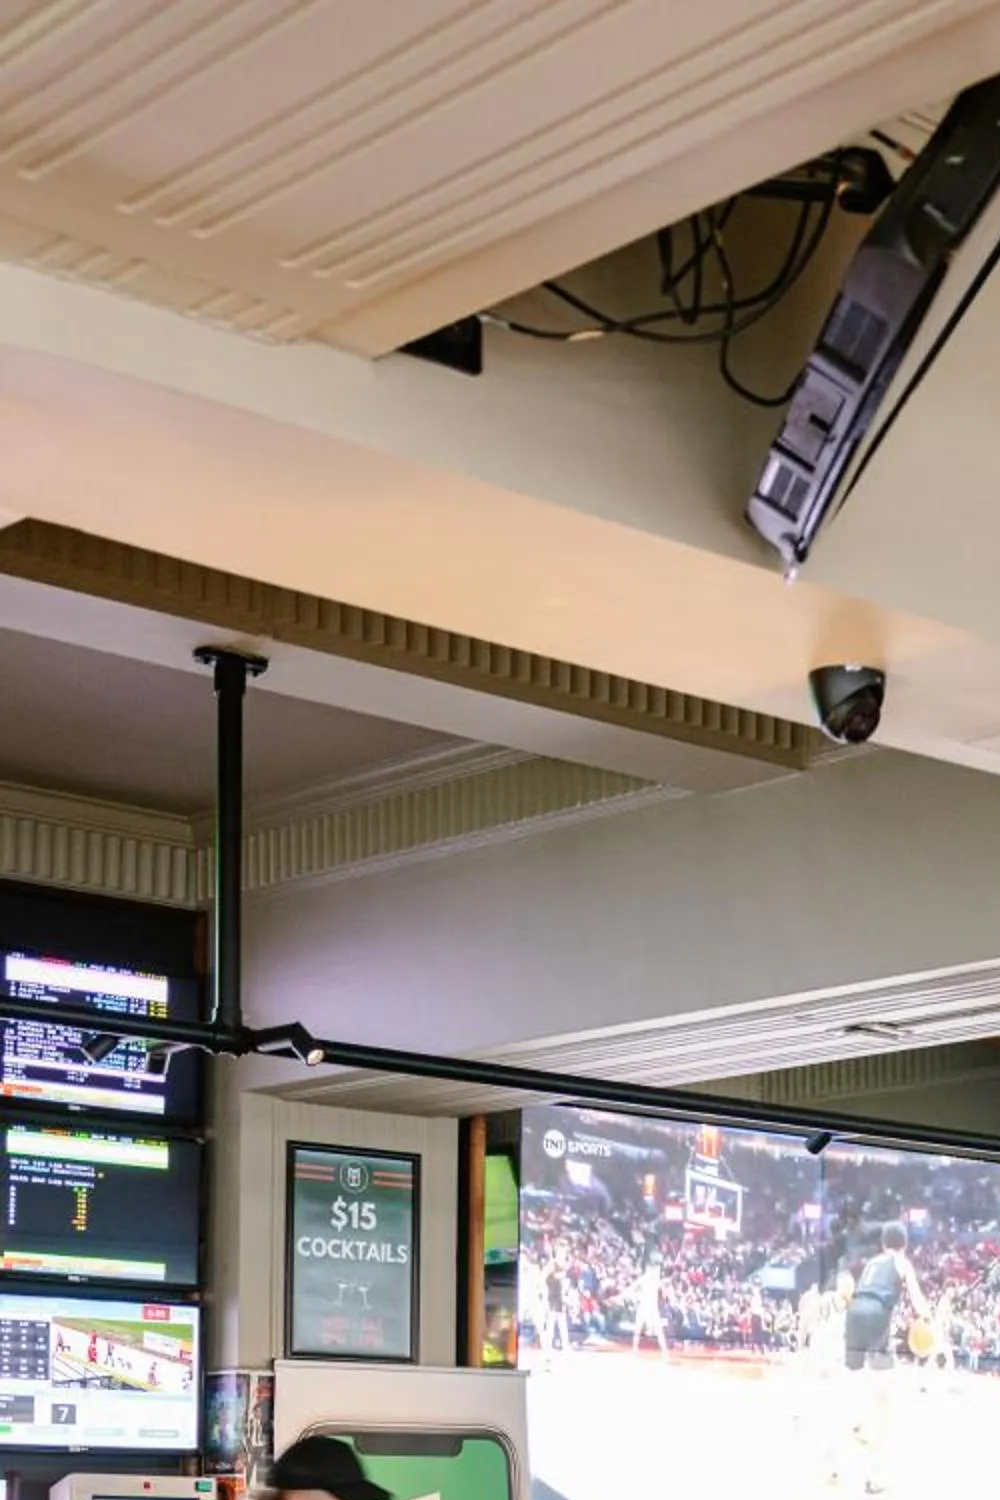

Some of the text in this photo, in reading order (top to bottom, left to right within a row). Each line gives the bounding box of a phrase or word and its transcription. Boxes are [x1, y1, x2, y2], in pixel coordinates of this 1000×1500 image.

[568, 1140, 612, 1157] SPORTS
[330, 1196, 377, 1232] $15
[297, 1236, 409, 1265] COCKTAILS
[58, 1407, 69, 1422] 7
